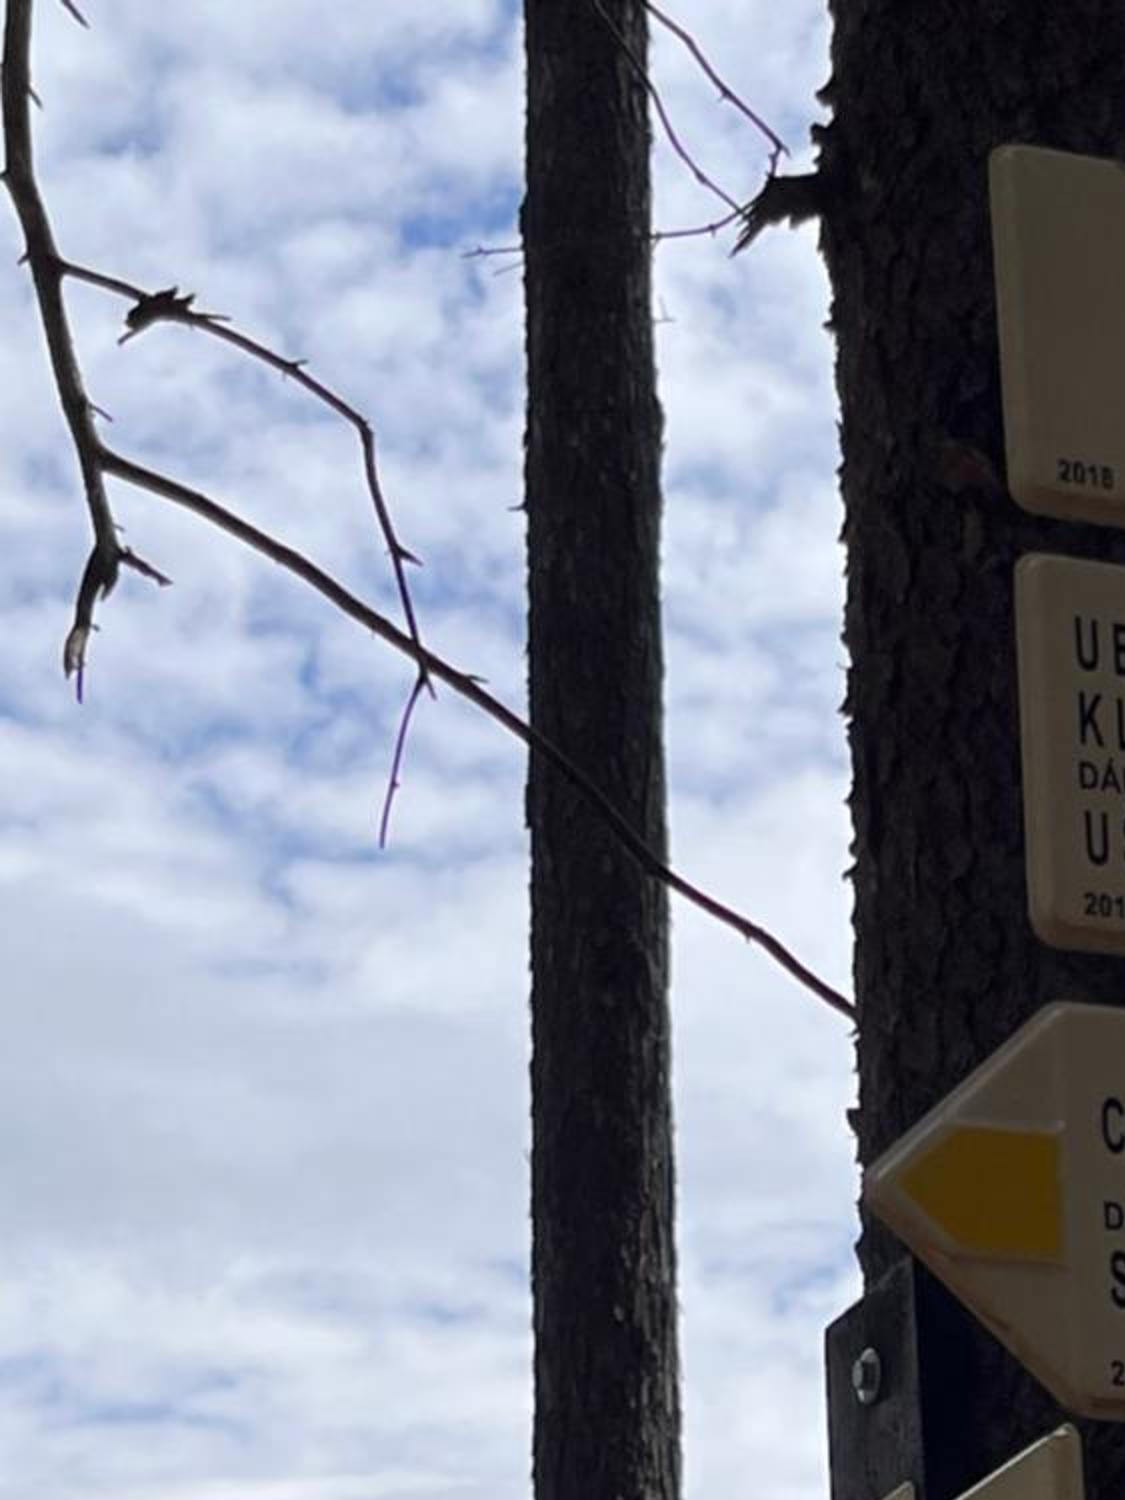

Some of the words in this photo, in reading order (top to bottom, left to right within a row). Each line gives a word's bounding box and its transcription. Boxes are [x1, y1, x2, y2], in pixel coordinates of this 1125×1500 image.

[1057, 457, 1115, 491] 2018
[1074, 615, 1099, 672] U
[1079, 690, 1104, 749] K
[1085, 809, 1110, 867] U
